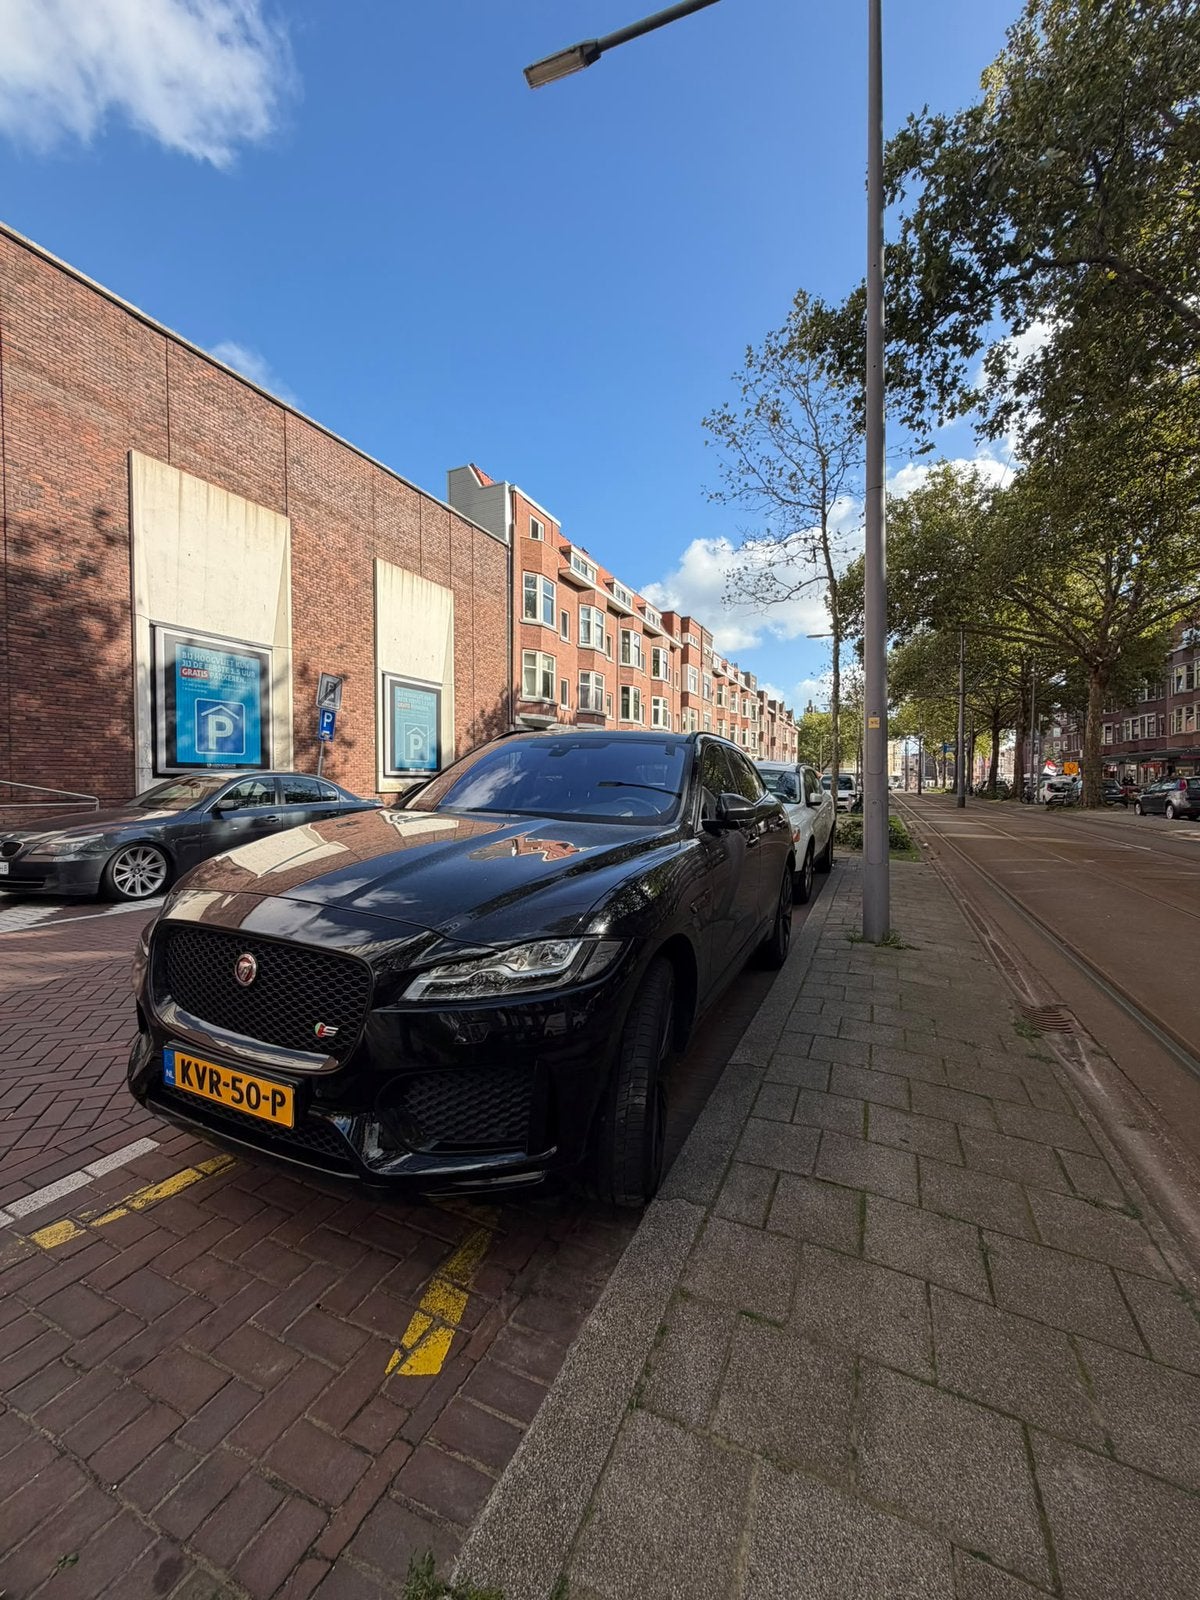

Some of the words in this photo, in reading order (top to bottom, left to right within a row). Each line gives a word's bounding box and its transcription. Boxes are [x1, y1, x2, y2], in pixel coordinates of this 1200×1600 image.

[182, 652, 192, 660] BIJ
[182, 668, 208, 678] GRATIS
[241, 670, 256, 678] UUR
[323, 712, 333, 728] P
[208, 714, 234, 750] P
[409, 733, 423, 758] P
[165, 1068, 175, 1078] NL
[180, 1058, 286, 1117] KVR-50-P
